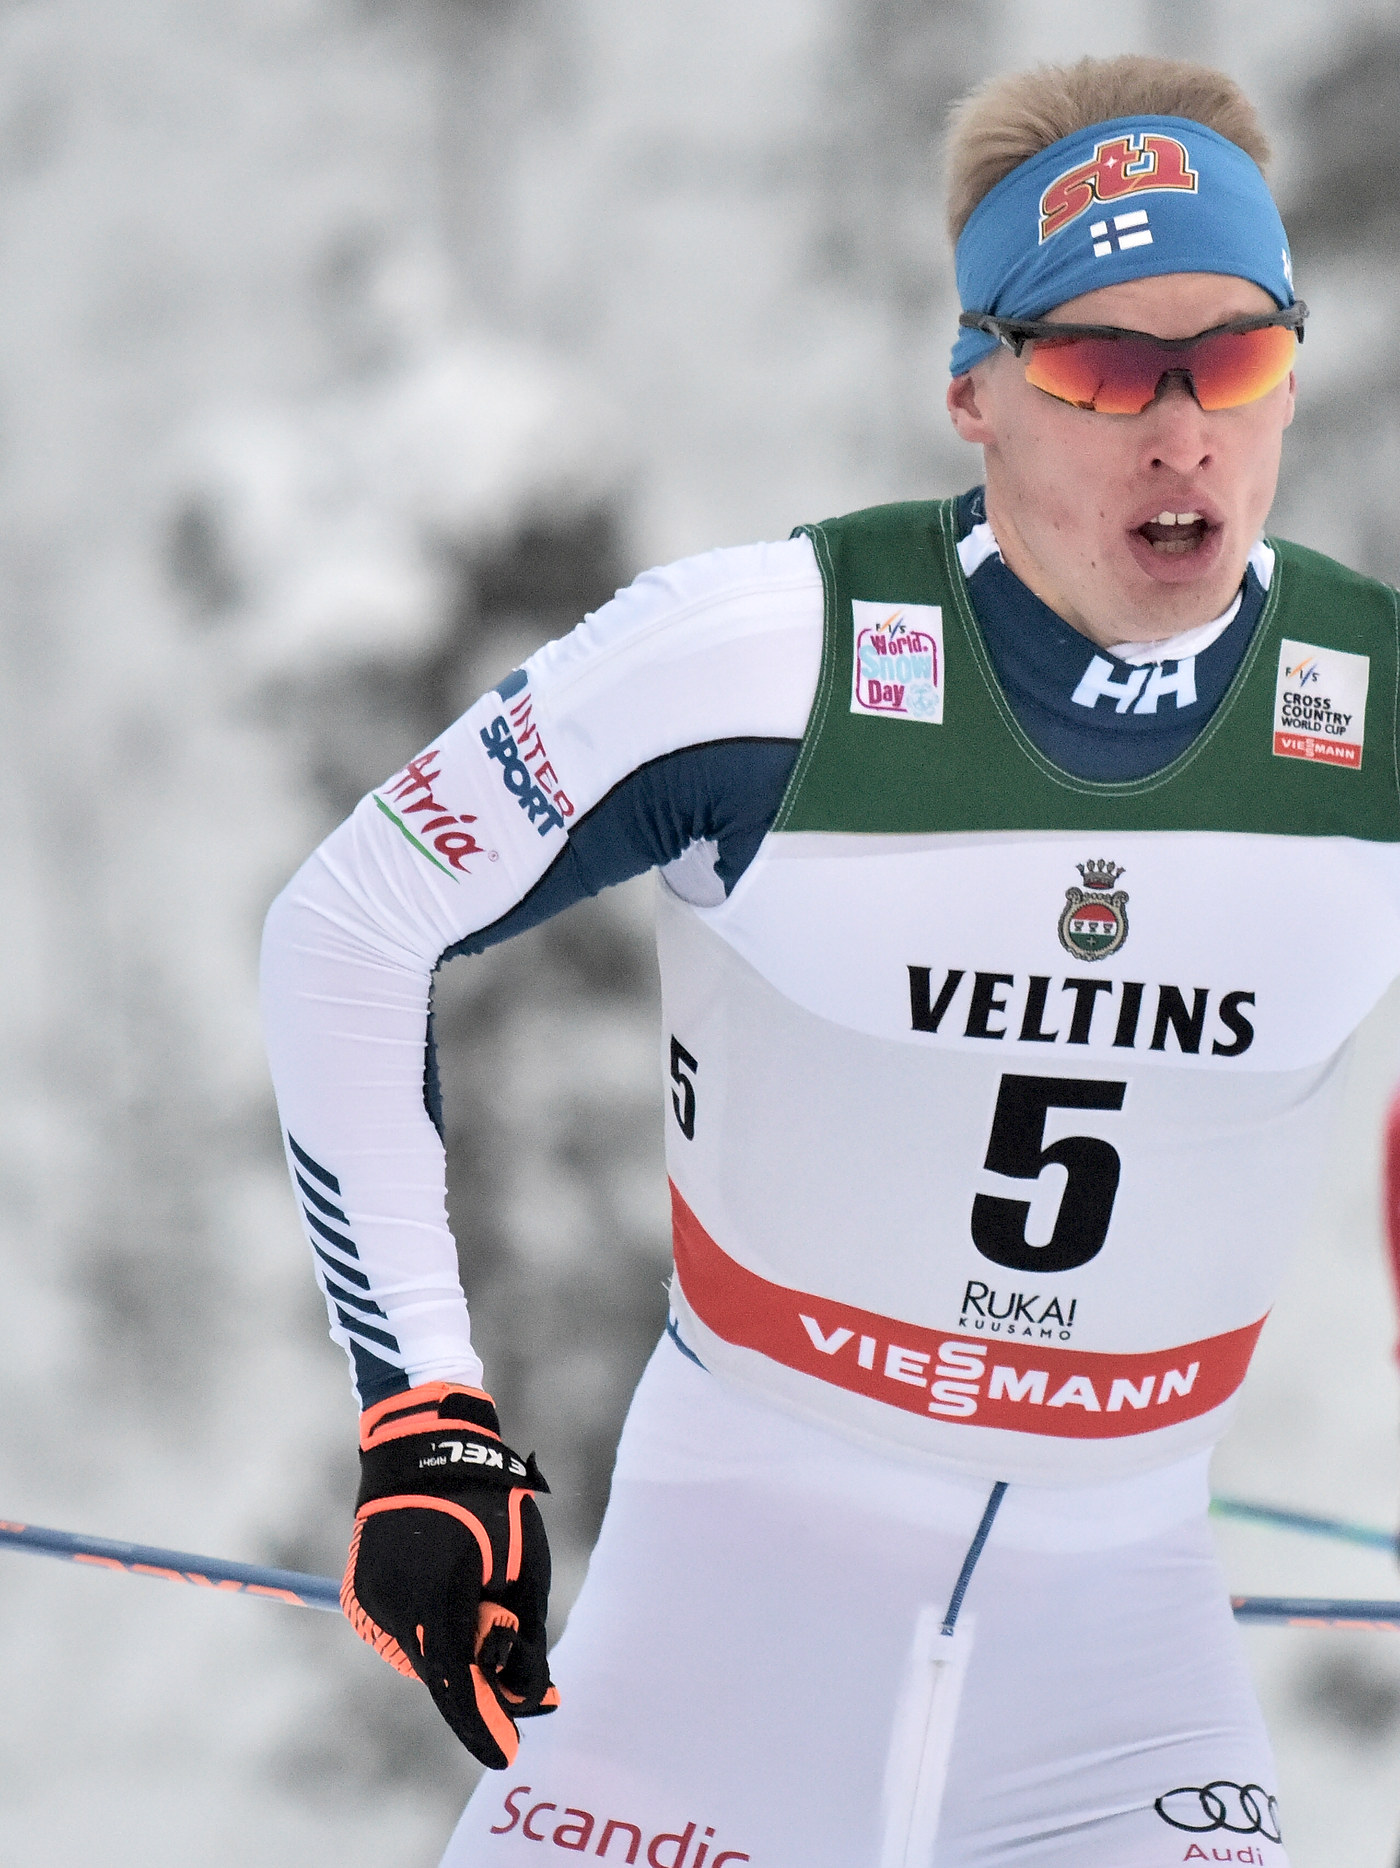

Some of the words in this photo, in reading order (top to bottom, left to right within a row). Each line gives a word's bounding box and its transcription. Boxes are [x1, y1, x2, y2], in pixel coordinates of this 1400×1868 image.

[859, 645, 932, 684] Snow
[868, 679, 905, 708] Day
[1283, 692, 1331, 710] CROSS
[1281, 716, 1322, 732] WORLD
[1325, 724, 1347, 737] CUP
[1282, 704, 1353, 726] COUNTRY
[510, 693, 575, 818] INTER
[1281, 738, 1355, 759] VIESSMANN
[480, 715, 565, 837] SPORT
[905, 964, 1256, 1057] VELTINS
[670, 1033, 699, 1141] 5
[971, 1073, 1128, 1273] 5
[961, 1280, 1078, 1327] RUKA!
[958, 1318, 1072, 1341] KUUSAMO
[799, 1313, 1202, 1418] VIESSMANN
[419, 1456, 447, 1469] RIGHT
[438, 1441, 527, 1477] EXEL
[1183, 1843, 1264, 1867] Audi
